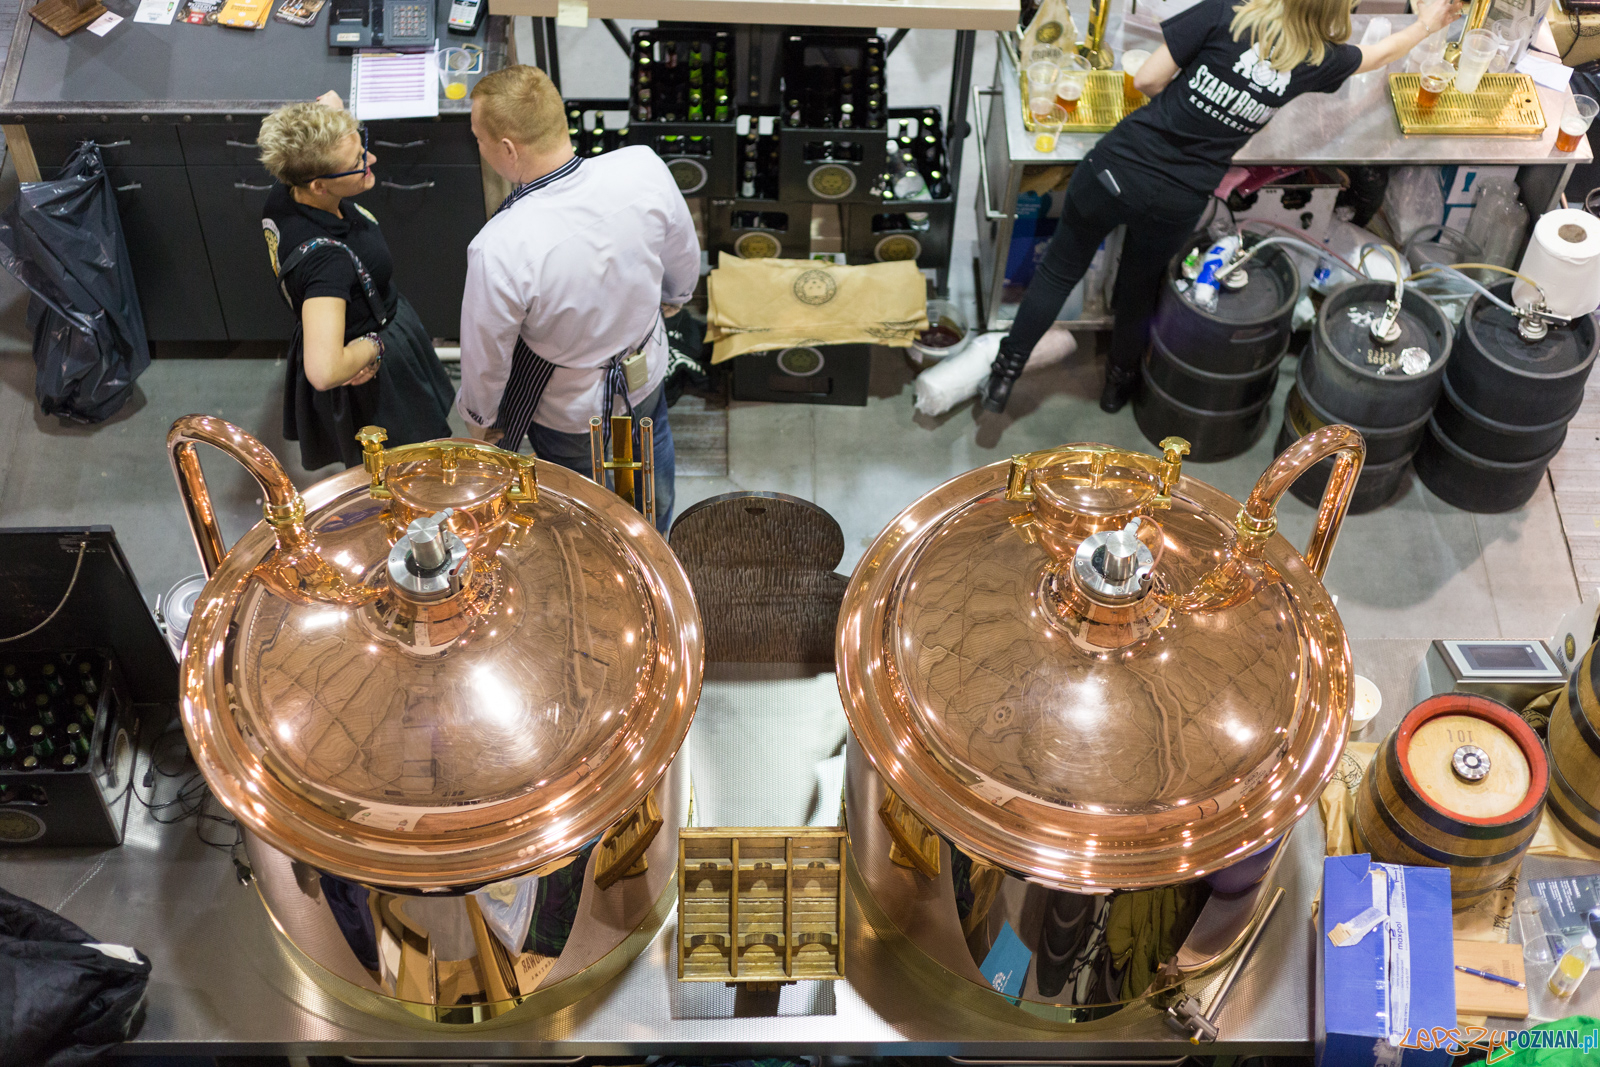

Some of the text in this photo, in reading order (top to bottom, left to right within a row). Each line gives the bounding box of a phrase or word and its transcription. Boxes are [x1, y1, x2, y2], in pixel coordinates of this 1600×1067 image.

[1188, 64, 1280, 125] STARY BROW
[1396, 921, 1404, 950] maxpol
